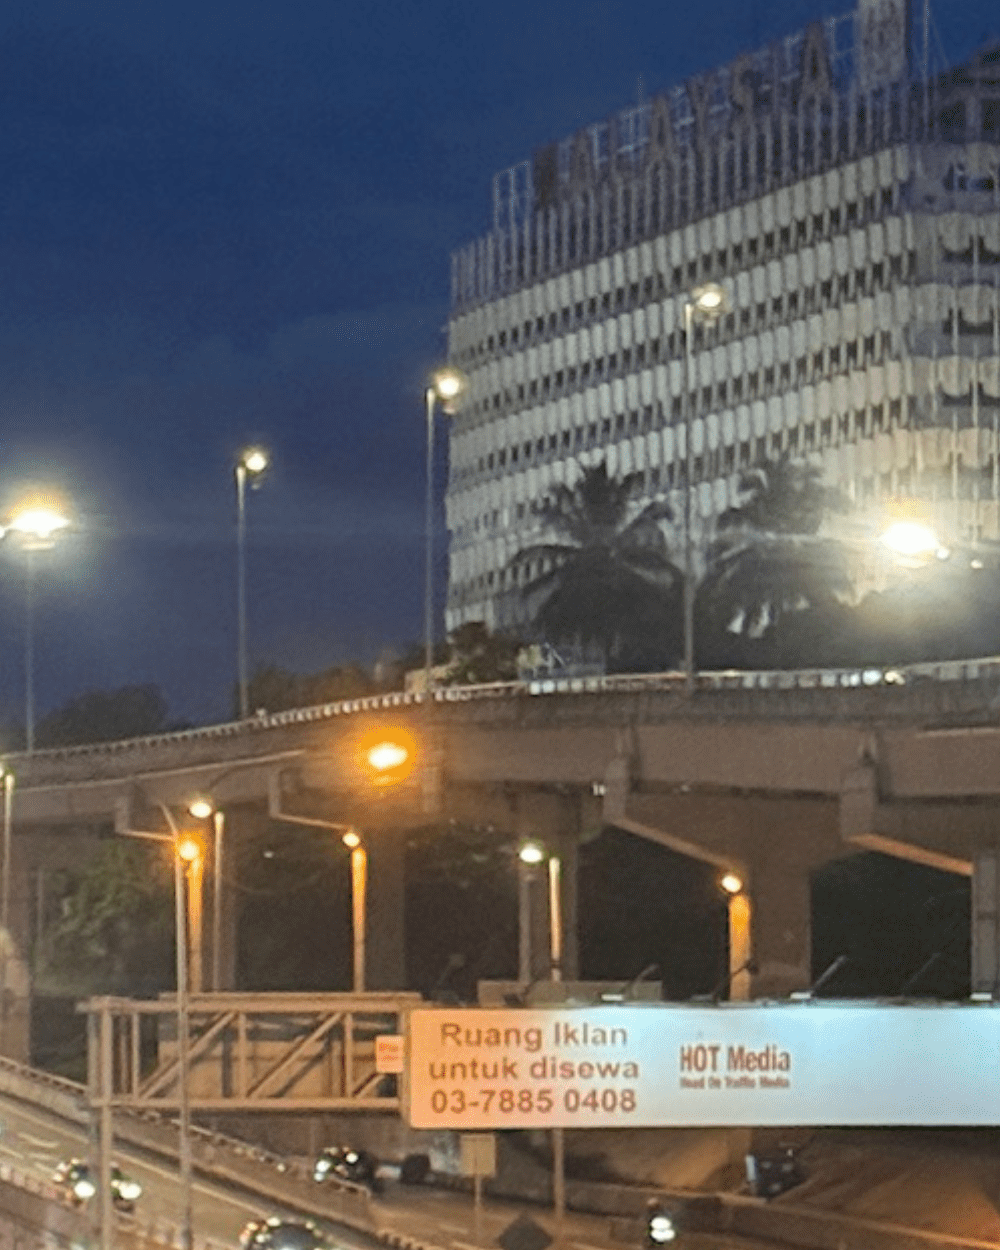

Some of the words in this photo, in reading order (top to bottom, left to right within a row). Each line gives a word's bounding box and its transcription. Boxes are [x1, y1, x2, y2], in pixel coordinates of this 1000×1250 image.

[440, 1021, 543, 1053] Ruang
[554, 1021, 628, 1046] Iklan
[428, 1056, 519, 1080] untuk
[680, 1045, 720, 1071] HOT
[727, 1043, 791, 1071] Media
[430, 1088, 554, 1114] 03-7885
[563, 1088, 638, 1113] 0408
